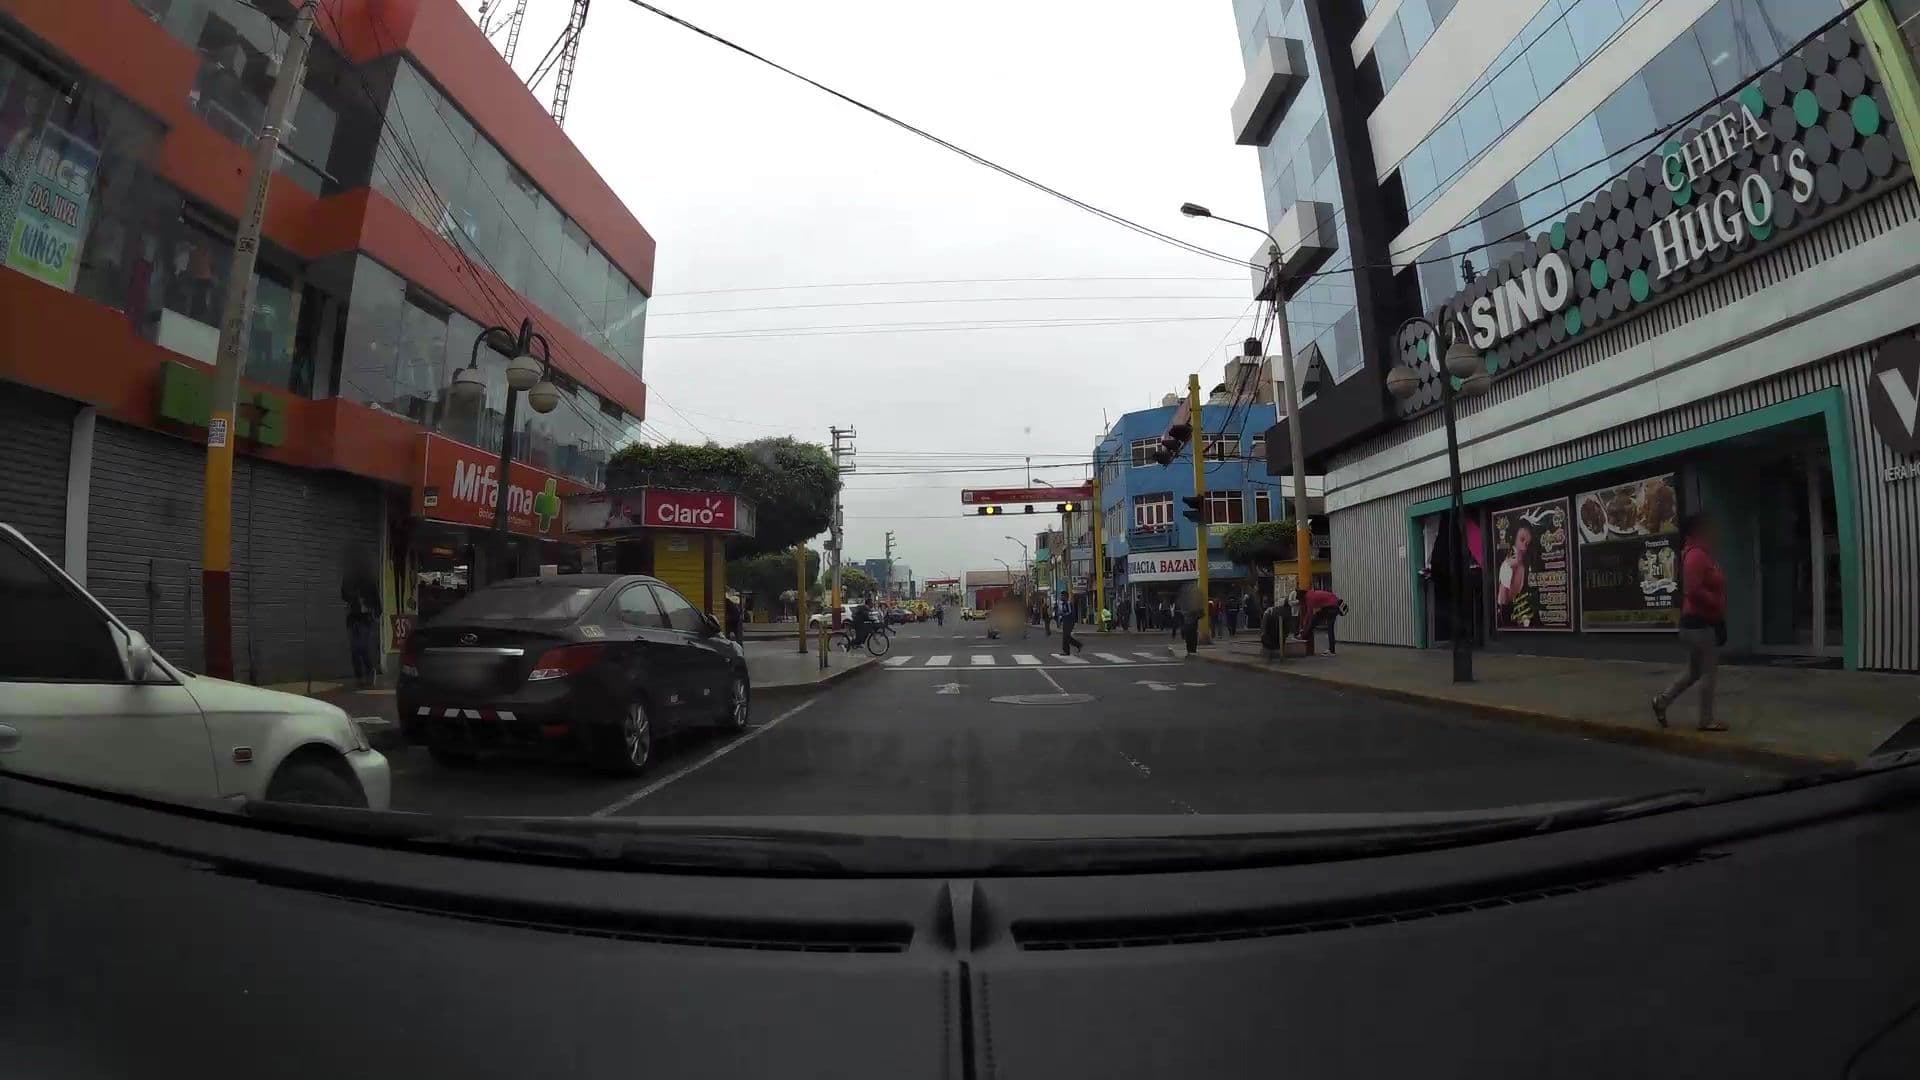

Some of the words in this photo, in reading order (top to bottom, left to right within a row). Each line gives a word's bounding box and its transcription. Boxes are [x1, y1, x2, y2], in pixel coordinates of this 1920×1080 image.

[1662, 103, 1767, 192] CHIFA
[52, 194, 80, 228] NIVEL
[20, 223, 66, 269] NIÑOS
[452, 459, 533, 515] Mifama
[657, 503, 714, 524] Claro
[1159, 558, 1197, 573] BAZAN
